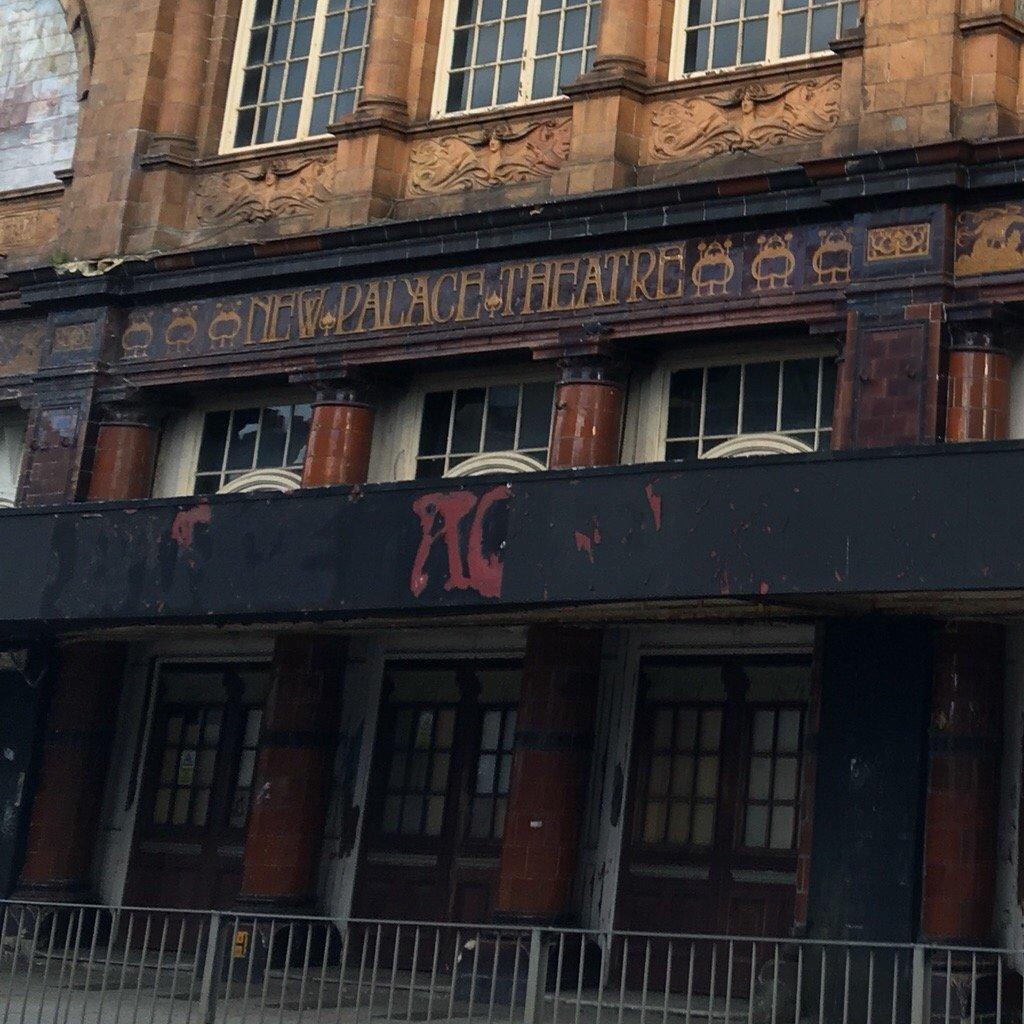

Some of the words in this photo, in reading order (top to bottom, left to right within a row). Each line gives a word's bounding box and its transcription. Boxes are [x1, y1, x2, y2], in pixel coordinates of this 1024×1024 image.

[243, 286, 331, 346] NEW
[333, 267, 486, 336] PALACE
[499, 240, 686, 318] THEATRE
